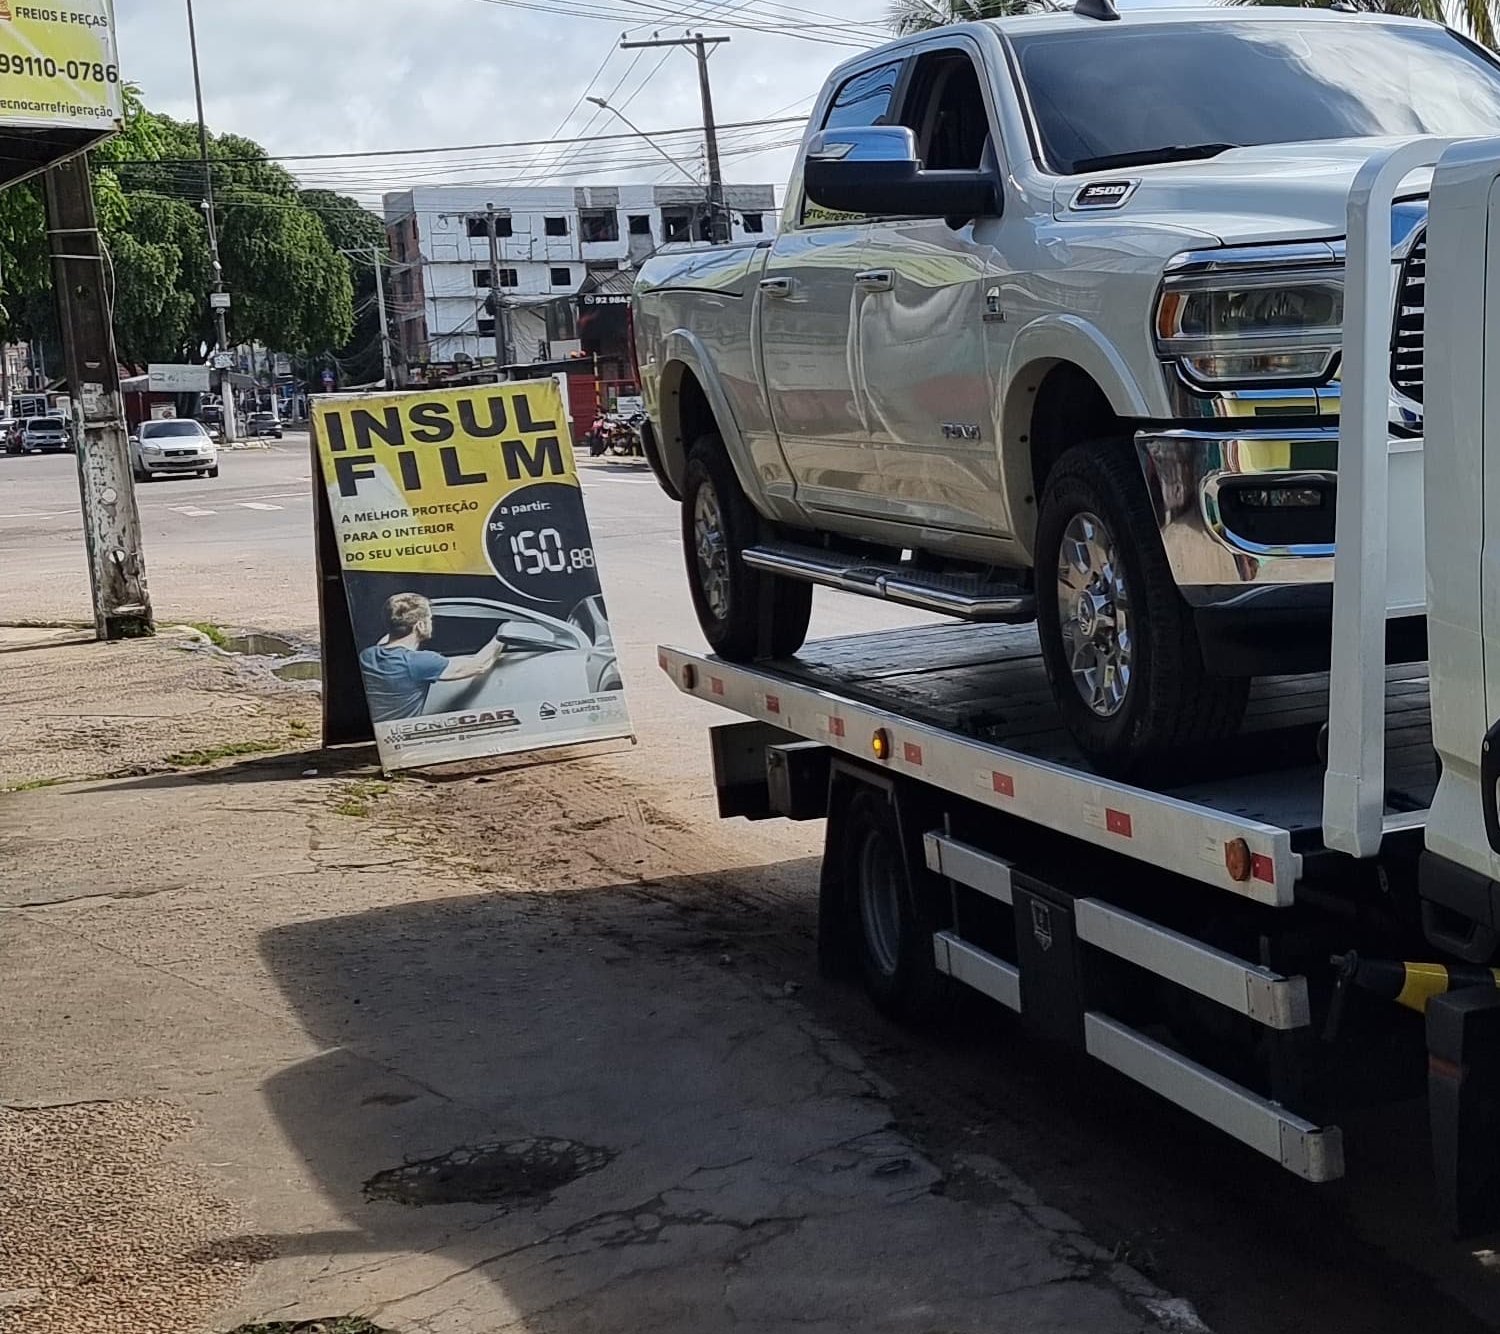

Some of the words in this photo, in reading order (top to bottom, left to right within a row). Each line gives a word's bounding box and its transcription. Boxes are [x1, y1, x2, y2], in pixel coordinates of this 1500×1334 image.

[15, 6, 58, 22] FREIOS
[60, 11, 68, 23] E
[70, 13, 108, 28] PEÇAS
[0, 54, 118, 83] 99110-0786
[0, 99, 113, 119] ecnocarrefrigeração
[1085, 185, 1127, 197] 3500
[323, 394, 557, 452] INSUL
[334, 436, 565, 498] FILM
[341, 514, 351, 524] A
[354, 509, 409, 523] MELHOR
[412, 500, 479, 517] PROTEÇÃO
[500, 506, 508, 515] a
[343, 530, 378, 543] PARA
[382, 529, 392, 540] O
[395, 523, 455, 537] INTERIOR
[345, 551, 365, 563] DO
[368, 549, 392, 560] SEU
[396, 543, 449, 557] VEÍCULO
